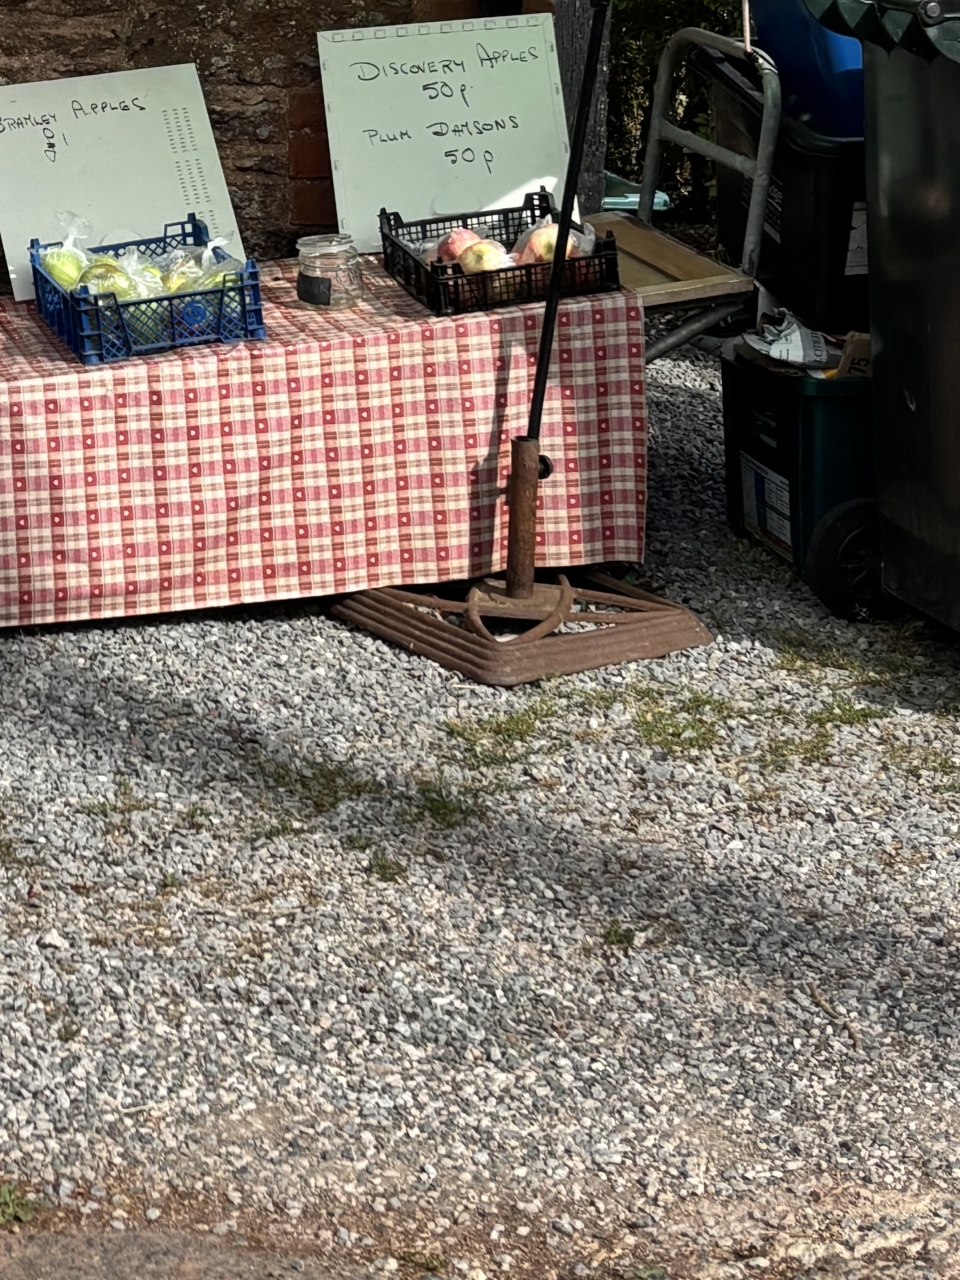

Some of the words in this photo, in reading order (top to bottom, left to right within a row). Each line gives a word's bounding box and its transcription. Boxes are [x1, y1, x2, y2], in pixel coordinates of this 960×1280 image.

[349, 59, 466, 81] DISCOVERY
[475, 42, 540, 69] APPLES
[71, 97, 146, 119] APPLES
[362, 128, 412, 146] PLUM
[426, 115, 520, 138] DAMSONS
